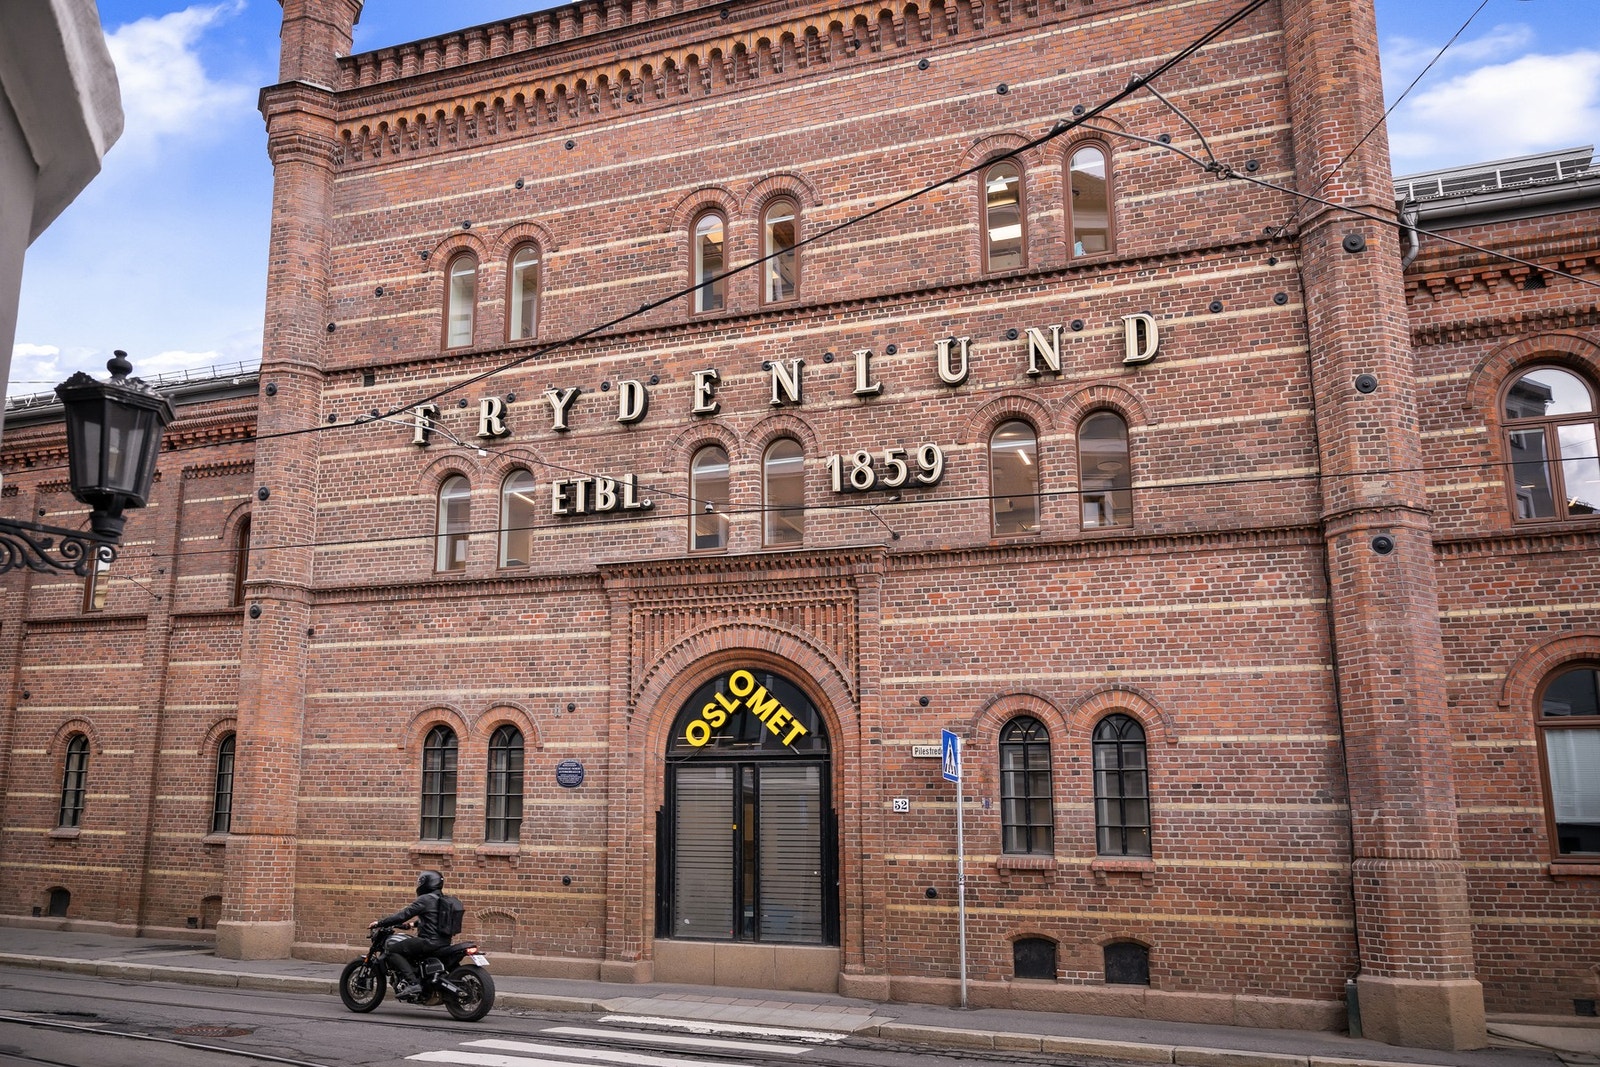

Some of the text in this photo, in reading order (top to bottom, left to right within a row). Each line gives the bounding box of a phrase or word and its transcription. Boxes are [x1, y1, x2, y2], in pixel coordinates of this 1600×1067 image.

[411, 312, 1161, 446] FRYDENLUND
[551, 443, 945, 516] ETBL. 1859
[914, 746, 942, 756] Pilestred
[894, 800, 908, 810] 52
